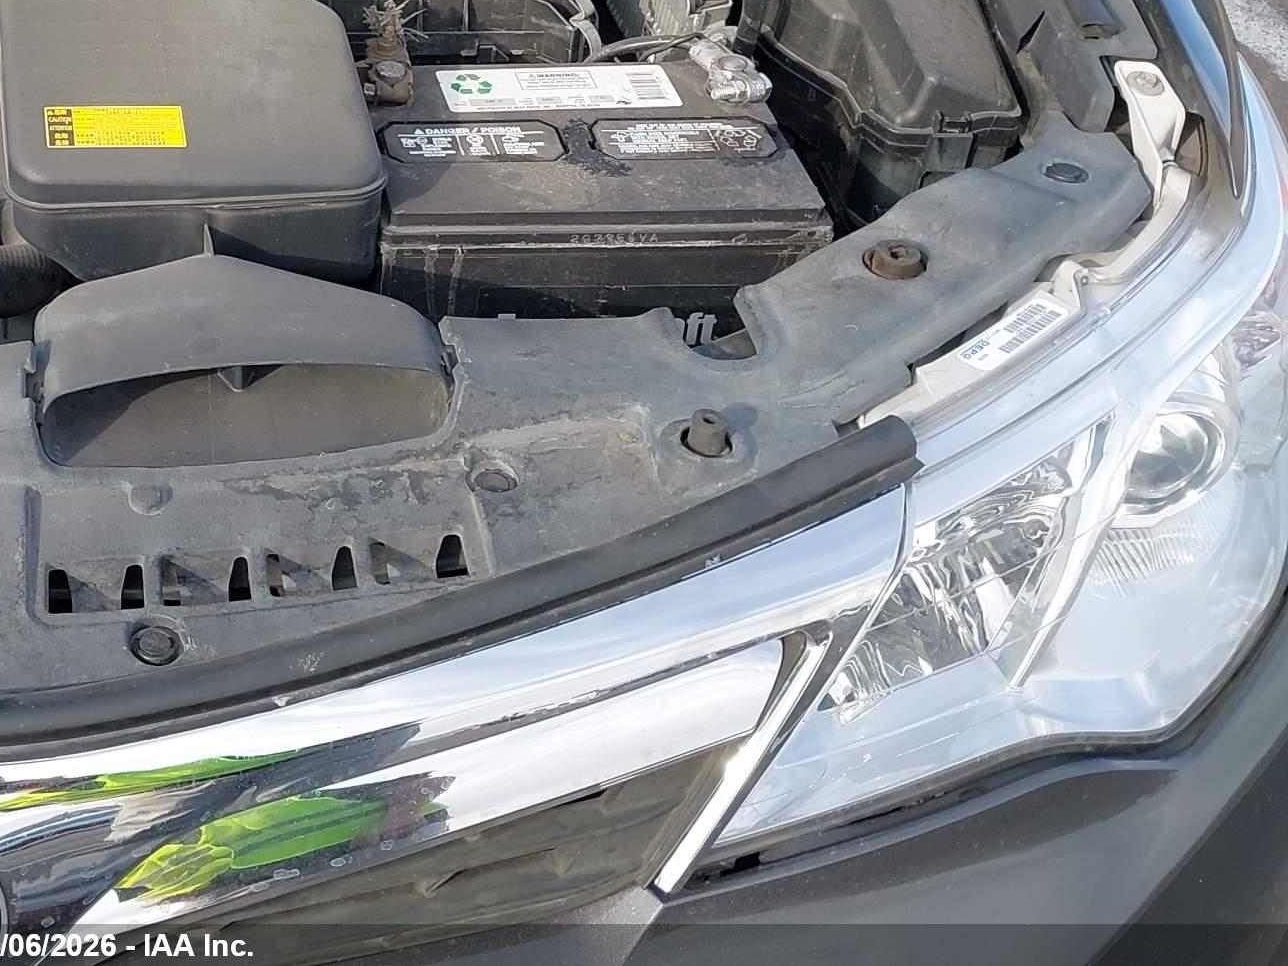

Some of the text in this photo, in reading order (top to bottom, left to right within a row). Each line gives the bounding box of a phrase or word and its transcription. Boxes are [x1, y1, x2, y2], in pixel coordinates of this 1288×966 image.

[424, 127, 470, 135] DANGER
[480, 126, 522, 134] POISON
[962, 339, 991, 361] DEPO
